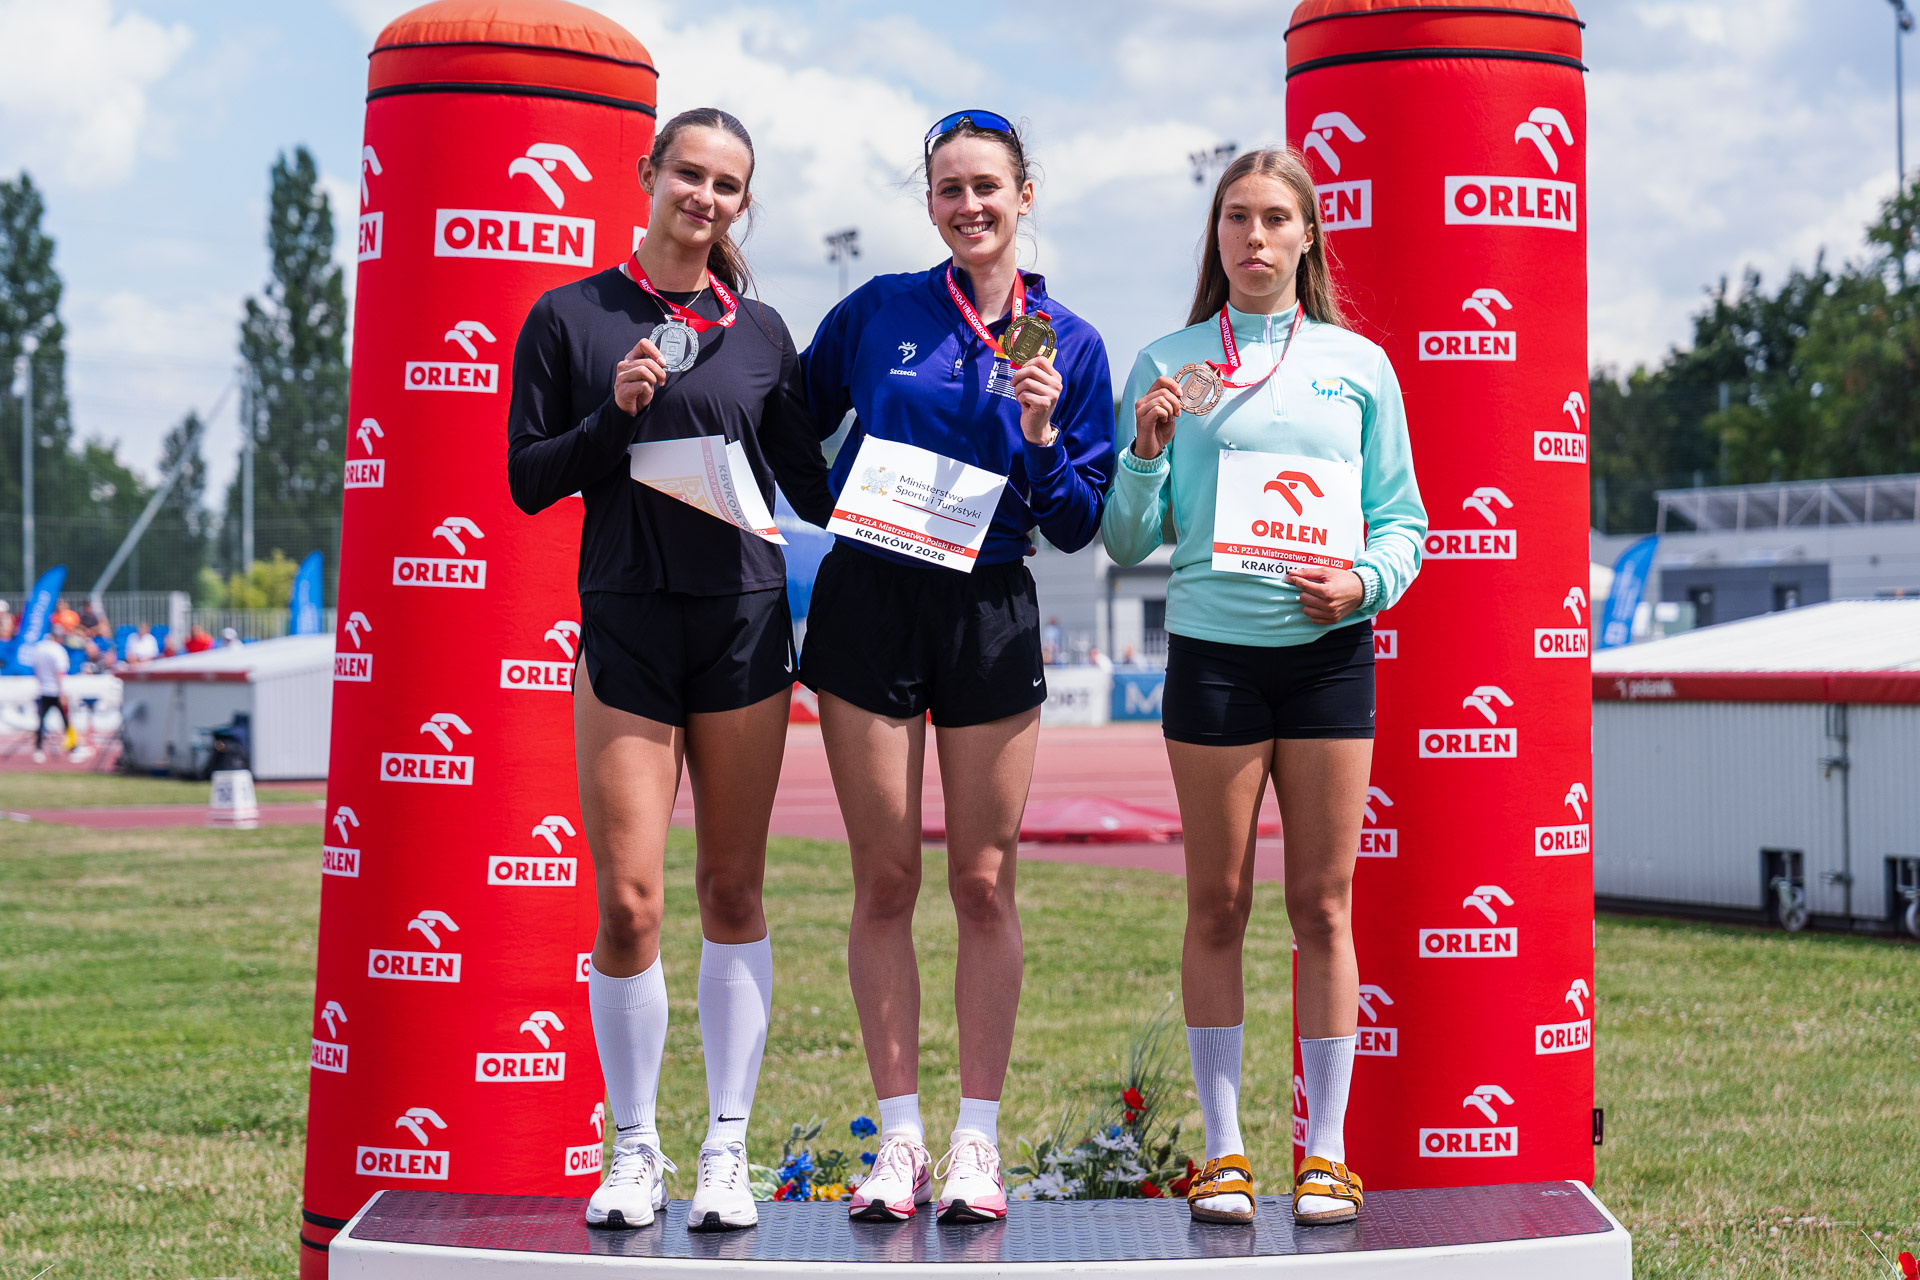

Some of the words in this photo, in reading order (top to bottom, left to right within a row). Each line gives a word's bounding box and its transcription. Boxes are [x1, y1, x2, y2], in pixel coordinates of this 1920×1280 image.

[1455, 184, 1571, 222] ORLEN
[444, 217, 584, 257] ORLEN
[962, 302, 991, 340] MISTRZOSTWA
[1221, 316, 1235, 356] MISTRZOSTWA
[1425, 336, 1510, 355] ORLEN
[410, 366, 491, 387] ORLEN
[890, 368, 917, 377] Szczecin
[1312, 380, 1343, 400] Sopot
[1539, 437, 1584, 458] ORLEN
[900, 475, 963, 503] Ministerstwo
[896, 485, 929, 502] Sportu
[937, 499, 981, 519] Turystyki
[846, 513, 858, 522] 43.
[859, 516, 877, 528] PZLA
[878, 521, 925, 541] Mistrzostwa
[926, 535, 949, 550] Polski
[950, 544, 965, 554] U23
[1251, 520, 1327, 546] ORLEN
[855, 528, 914, 551] KRAKÓW
[915, 546, 946, 561] 2026
[1425, 535, 1510, 554] ORLEN
[1227, 545, 1239, 553] 43.
[1241, 547, 1259, 555] PZLA
[1261, 549, 1307, 562] Mistrzostwa
[1308, 556, 1329, 566] Polski
[1331, 560, 1344, 568] U23
[398, 562, 479, 583] ORLEN
[1539, 634, 1586, 653] ORLEN
[1425, 734, 1510, 753] ORLEN
[385, 758, 466, 780] ORLEN
[1540, 829, 1587, 851] ORLEN
[495, 861, 571, 881] ORLEN
[1425, 933, 1511, 953] ORLEN
[373, 954, 454, 977] ORLEN
[1540, 1025, 1588, 1049] ORLEN
[483, 1058, 559, 1077] ORLEN
[1425, 1132, 1511, 1153] ORLEN
[361, 1152, 441, 1175] ORLEN
